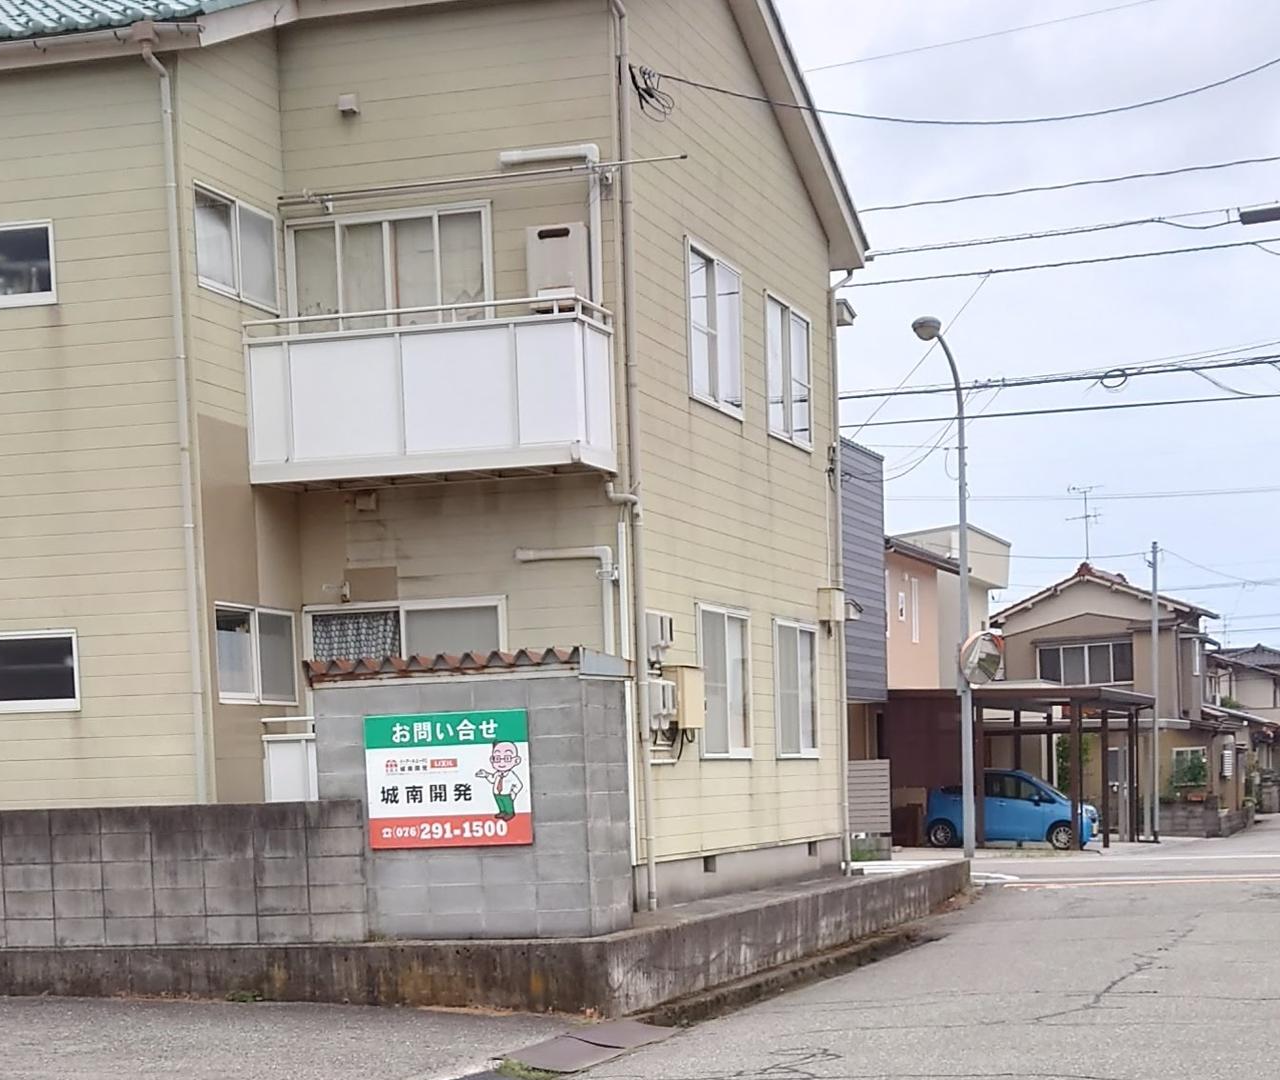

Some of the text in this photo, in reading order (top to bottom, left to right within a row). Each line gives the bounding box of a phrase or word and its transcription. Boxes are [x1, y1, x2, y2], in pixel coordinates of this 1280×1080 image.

[391, 719, 498, 743] お問い合せ
[380, 783, 472, 805] 城南開発
[393, 820, 508, 839] (076)291-1500
